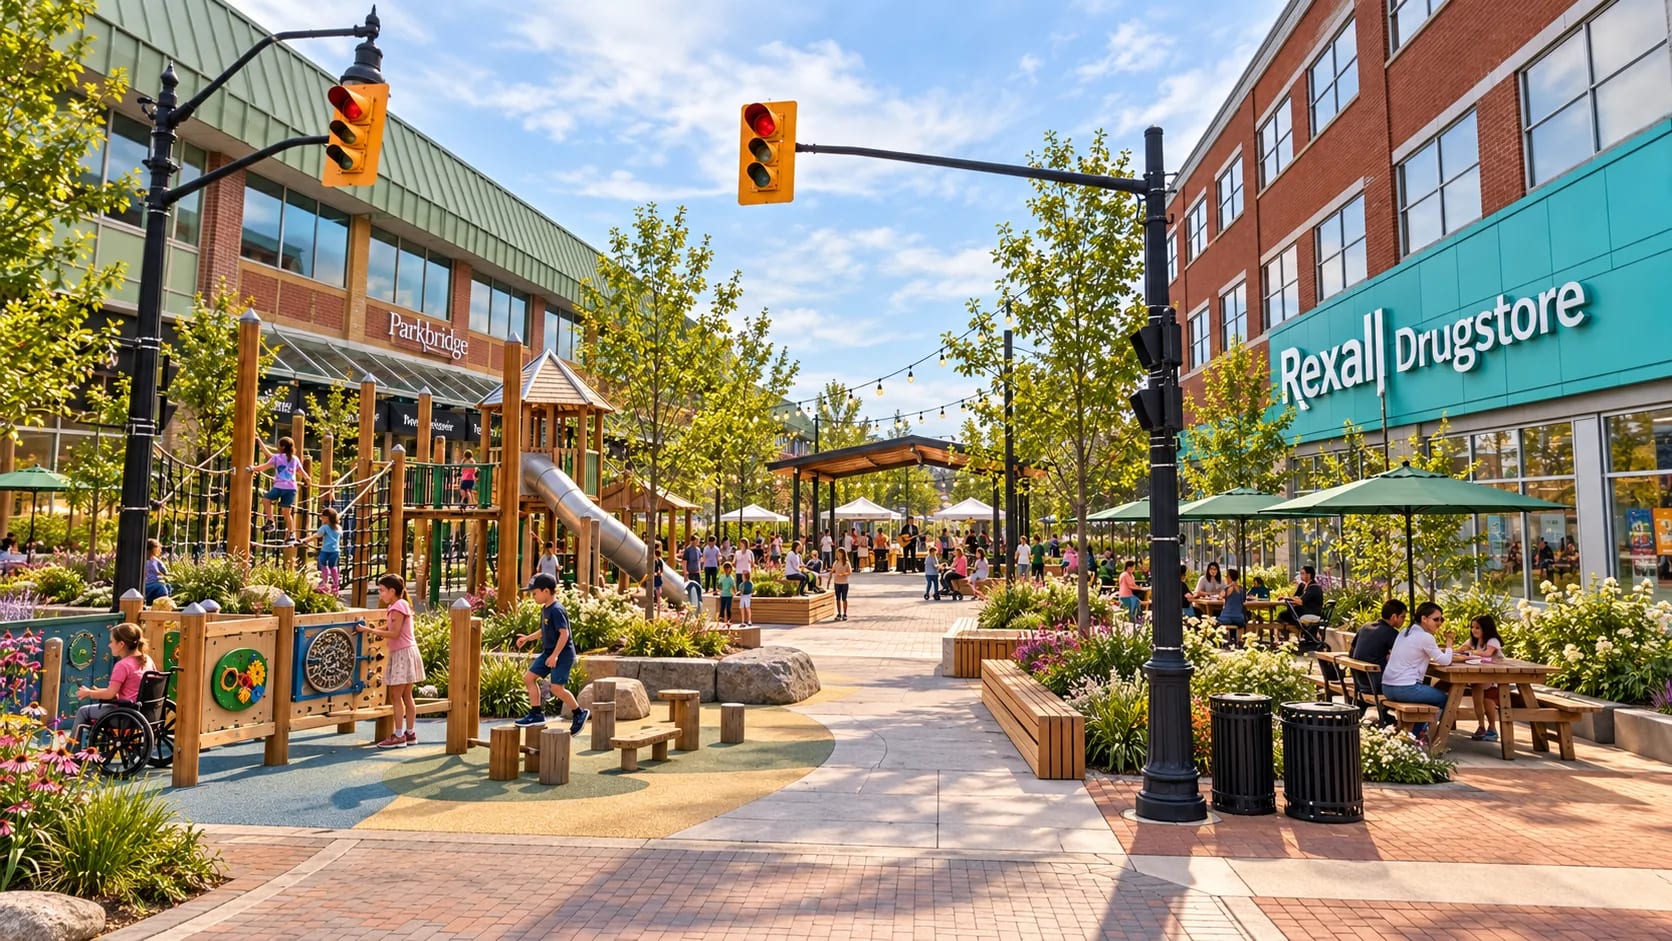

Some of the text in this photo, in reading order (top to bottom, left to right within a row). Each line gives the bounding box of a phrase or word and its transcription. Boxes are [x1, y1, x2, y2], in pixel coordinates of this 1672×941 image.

[388, 311, 468, 360] Parkbridge
[1281, 281, 1586, 410] Rexall Drugstore
